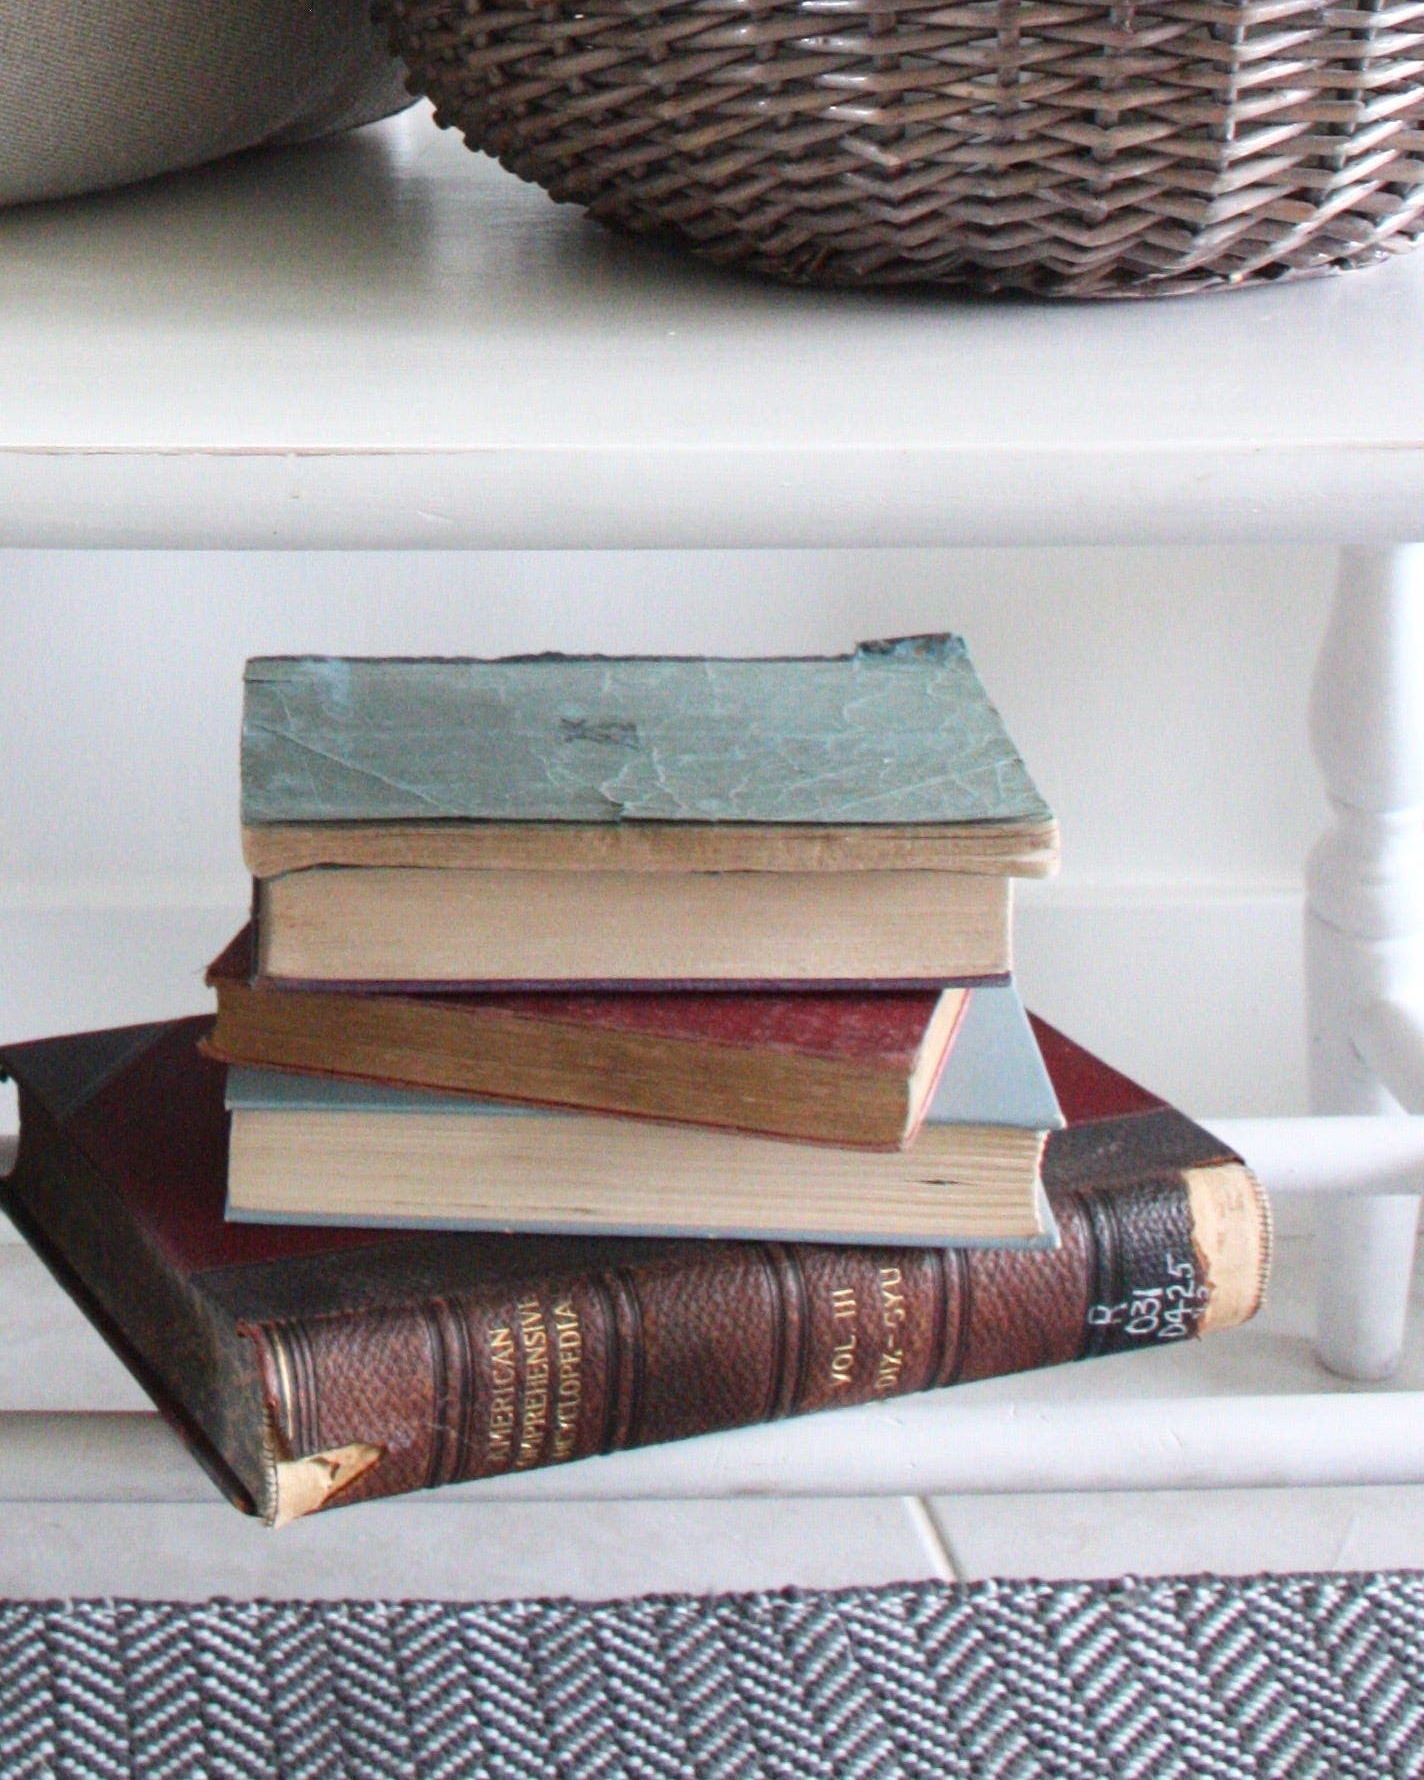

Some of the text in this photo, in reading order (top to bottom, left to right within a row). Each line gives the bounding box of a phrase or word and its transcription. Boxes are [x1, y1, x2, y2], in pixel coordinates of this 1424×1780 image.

[830, 1287, 857, 1319] III
[1088, 1301, 1128, 1325] R
[1124, 1287, 1163, 1334] 031
[1158, 1253, 1196, 1338] D425
[488, 1327, 516, 1463] AMERICAN
